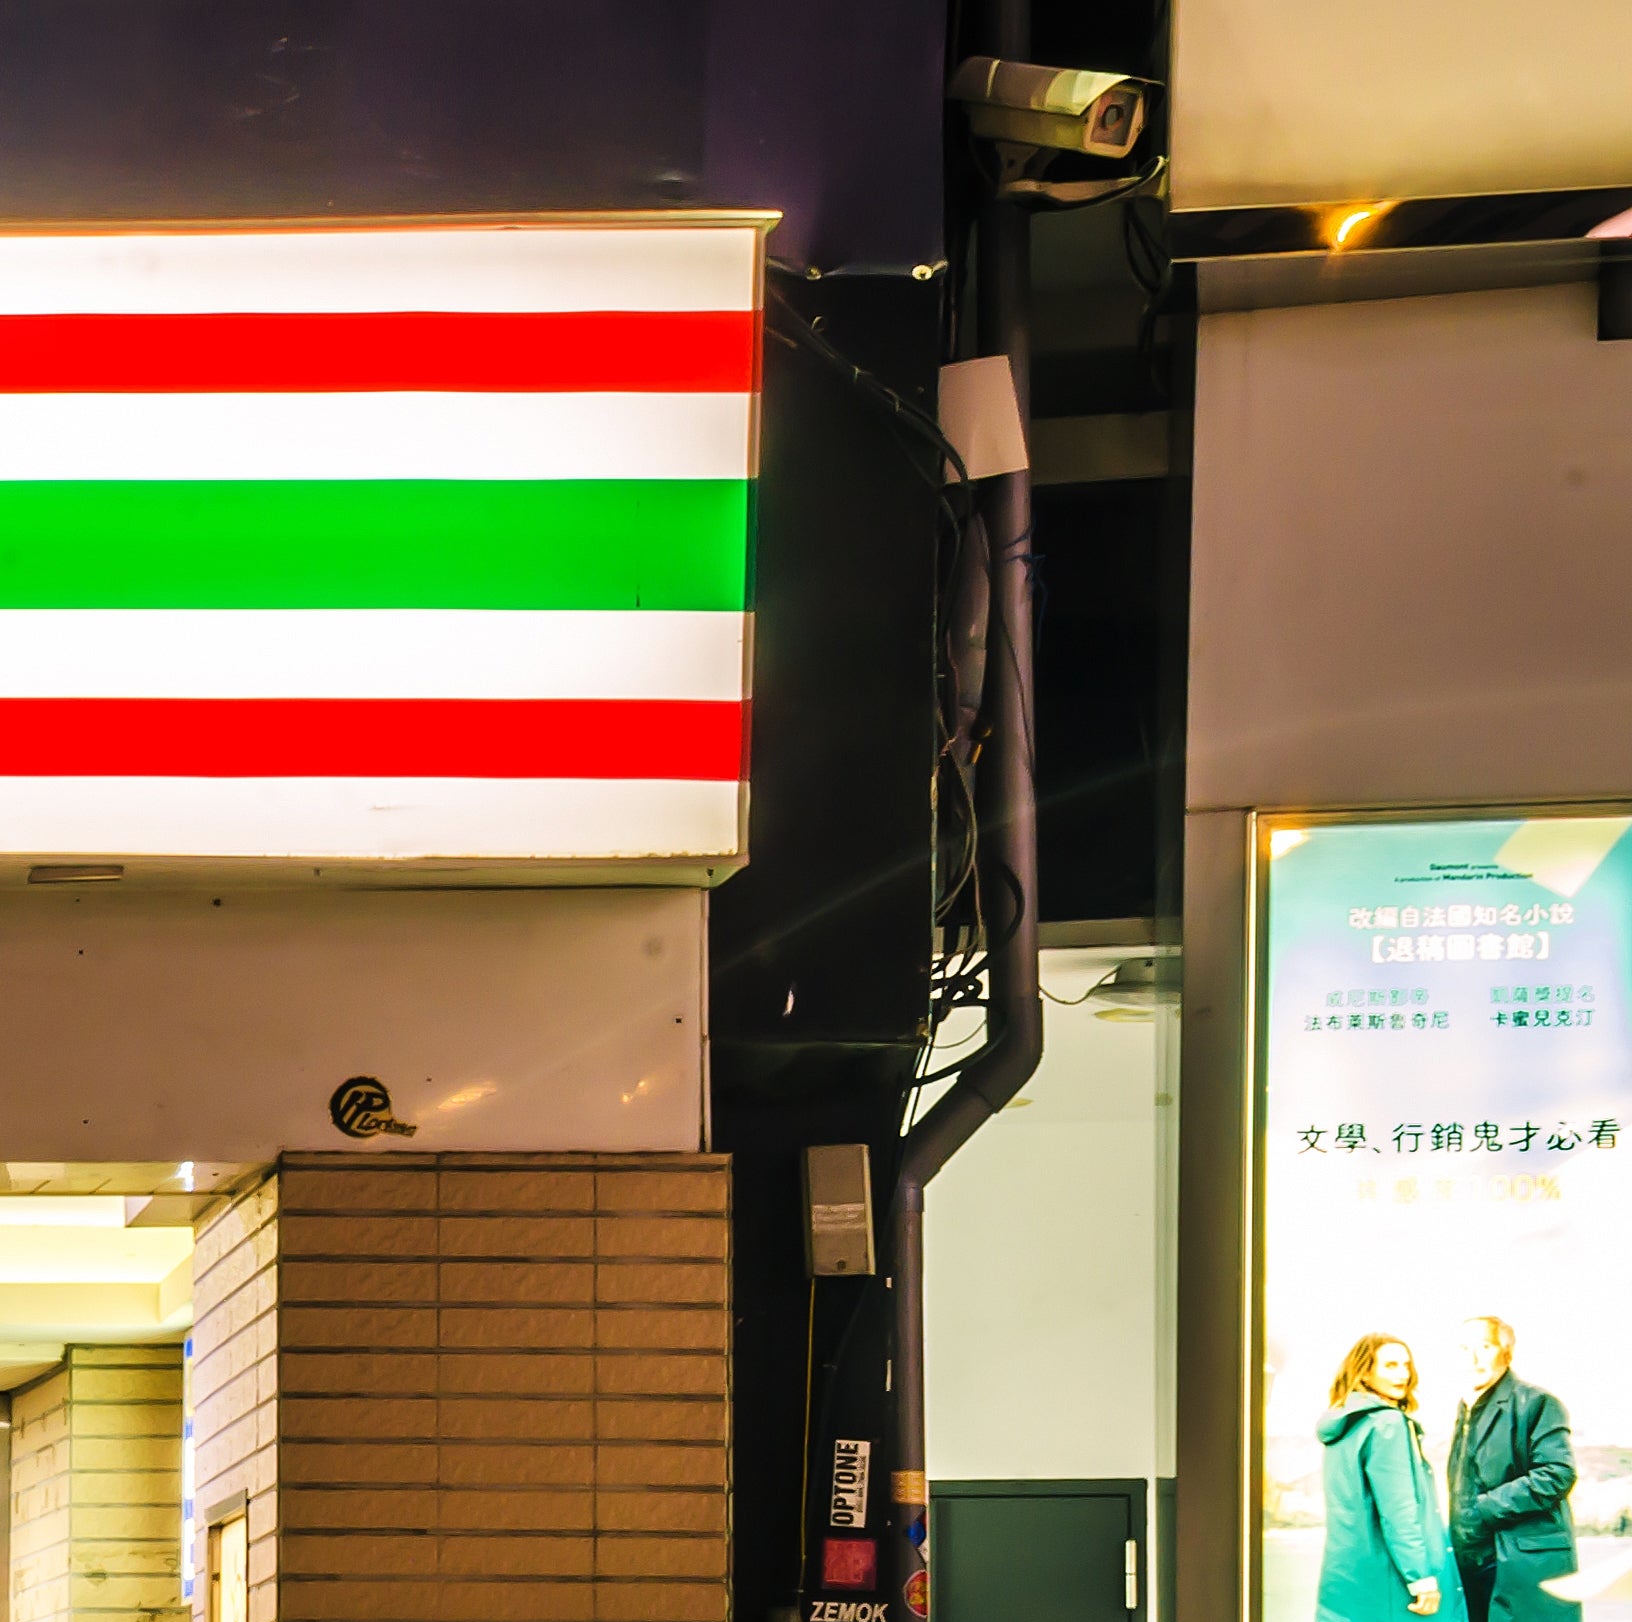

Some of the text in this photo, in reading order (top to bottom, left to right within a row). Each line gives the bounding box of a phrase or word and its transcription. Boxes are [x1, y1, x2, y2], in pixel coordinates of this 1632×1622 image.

[1348, 903, 1574, 931] 改編自法國知名小說
[1296, 1117, 1622, 1155] 文學、行銷鬼才必看
[832, 1442, 859, 1526] OPTONE
